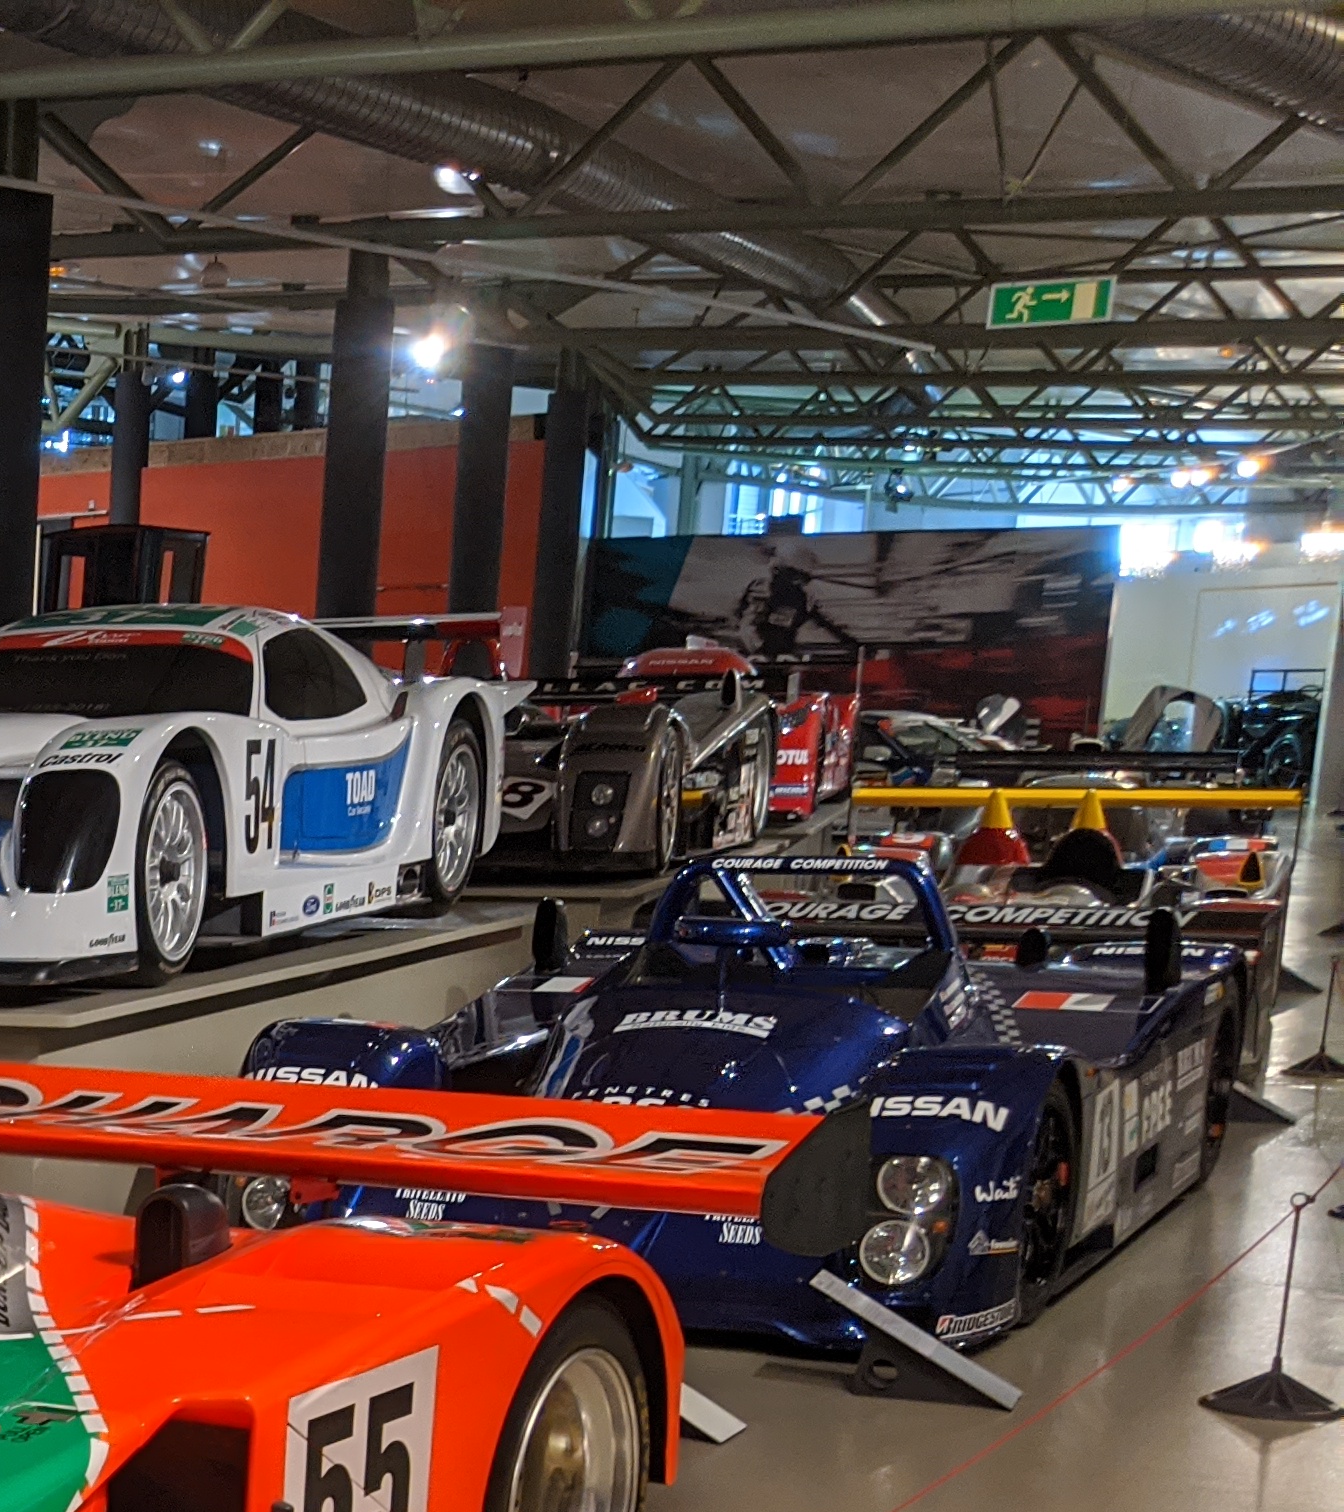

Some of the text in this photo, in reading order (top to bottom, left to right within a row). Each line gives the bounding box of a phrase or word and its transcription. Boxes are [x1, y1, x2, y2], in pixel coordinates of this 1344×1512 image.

[39, 752, 124, 769] Castrol
[775, 749, 809, 766] OTUL
[245, 739, 276, 853] 54
[345, 769, 376, 804] TOAD
[712, 857, 889, 870] COURAGE COMPETITION
[764, 900, 916, 922] OURAGE
[586, 936, 647, 946] NISS
[1092, 946, 1205, 957] NISN
[619, 1009, 779, 1031] BRUMS
[869, 1096, 1010, 1132] ISSAN
[718, 1221, 765, 1245] SEEDS
